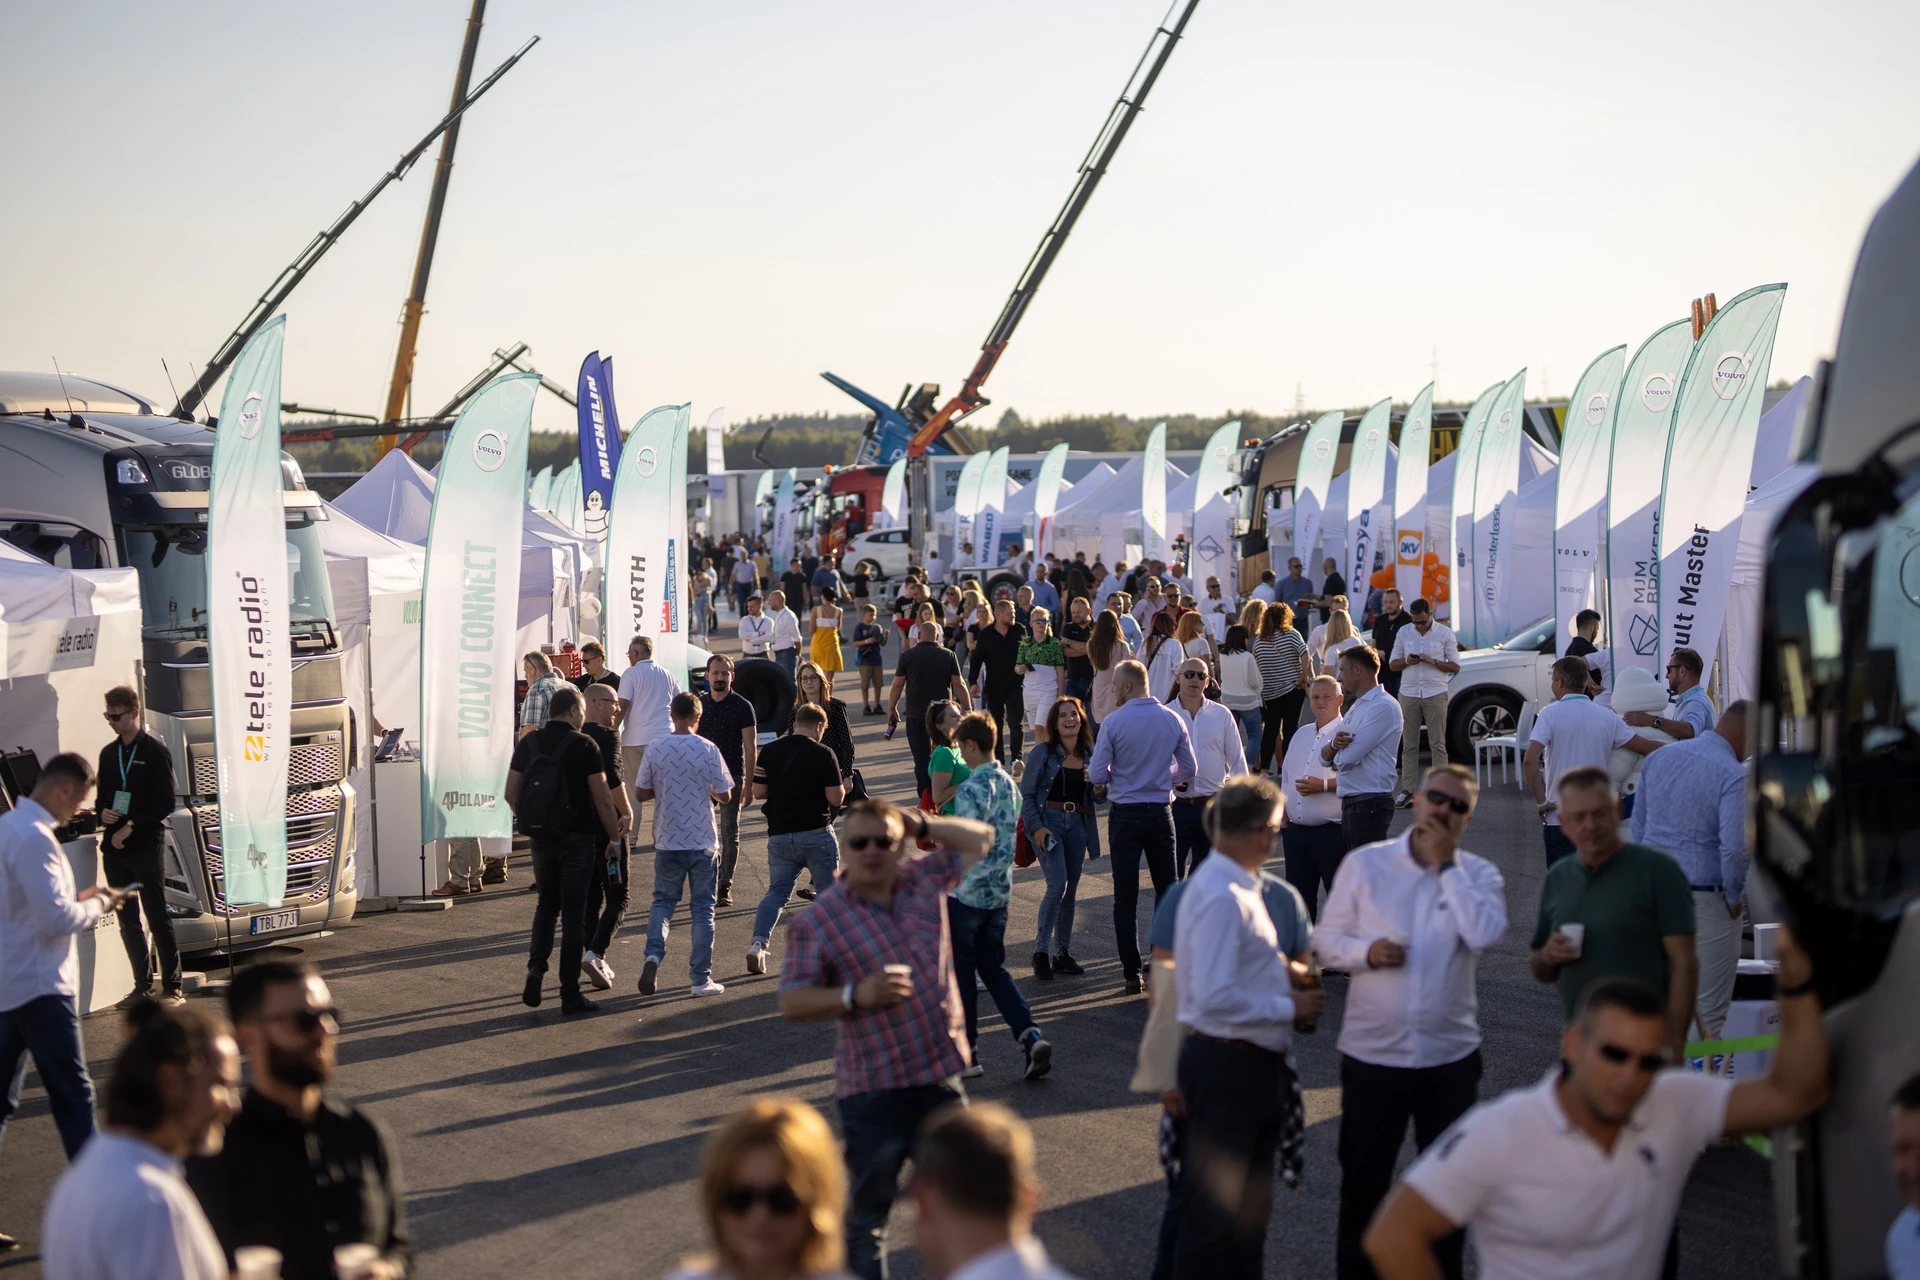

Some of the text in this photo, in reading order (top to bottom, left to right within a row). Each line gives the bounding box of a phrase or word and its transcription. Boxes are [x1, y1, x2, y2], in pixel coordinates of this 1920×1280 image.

[1717, 371, 1746, 380] VOLVO
[477, 445, 502, 456] VOLVO
[586, 375, 611, 480] MICHELIN
[172, 465, 211, 479] GLOB
[981, 512, 994, 563] WABCO
[1352, 509, 1372, 593] moya
[1400, 542, 1420, 554] DKV
[1486, 503, 1501, 580] masterlease
[1557, 548, 1590, 557] VOLV
[1633, 561, 1648, 604] MJM
[1677, 523, 1710, 606] Master
[259, 577, 272, 667] solutions
[669, 592, 678, 631] ELECTRONICS
[458, 540, 497, 739] VOLVO CONNECT
[244, 670, 265, 732] tele
[260, 912, 295, 931] TBL 77J
